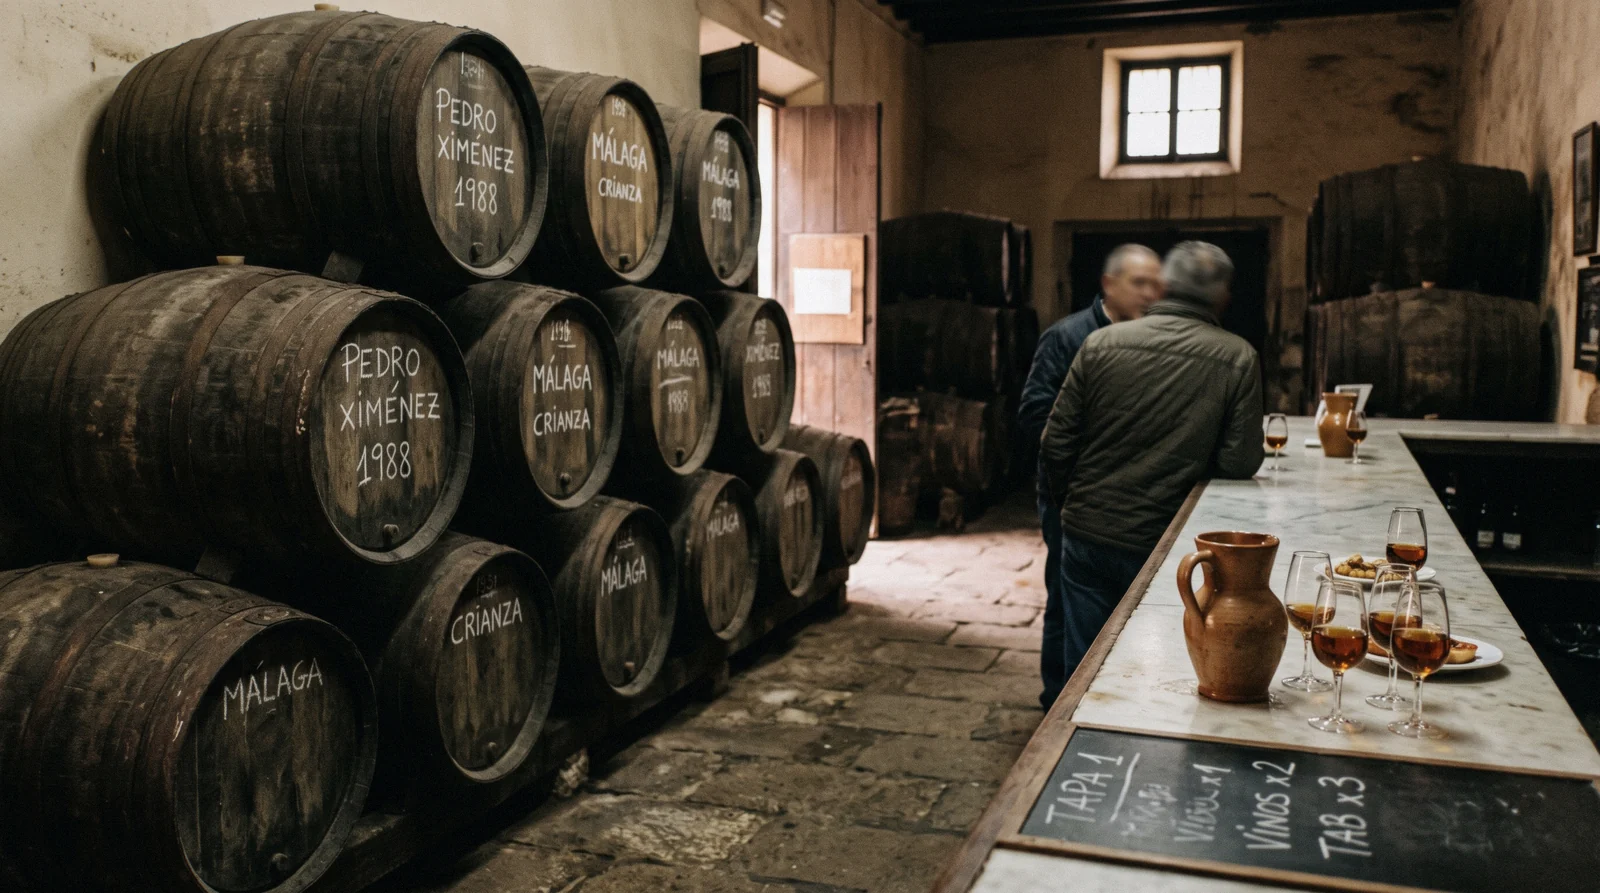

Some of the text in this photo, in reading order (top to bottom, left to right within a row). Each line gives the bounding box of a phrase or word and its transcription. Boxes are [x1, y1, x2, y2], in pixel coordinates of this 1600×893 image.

[436, 87, 497, 134] PEDRO
[437, 133, 515, 175] XIMÉNEZ
[592, 127, 648, 173] MÁLAGA
[454, 175, 498, 215] 1988
[598, 176, 643, 204] CRIANZA
[702, 156, 740, 191] MÁLAGA
[340, 342, 421, 383] PEDRO
[533, 355, 592, 394] MÁLAGA
[657, 340, 700, 371] MÁLAGA
[339, 380, 441, 432] XIMÉNEZ
[533, 402, 592, 436] CRIANZA
[356, 441, 412, 487] 1988
[601, 555, 648, 598] MÁLAGA
[451, 597, 523, 645] CRIANZA
[223, 657, 324, 720] MÁLAGA
[1045, 752, 1124, 824] TAPA 1
[1236, 760, 1297, 850] VINOS x2
[1317, 776, 1373, 859] TAB x3
